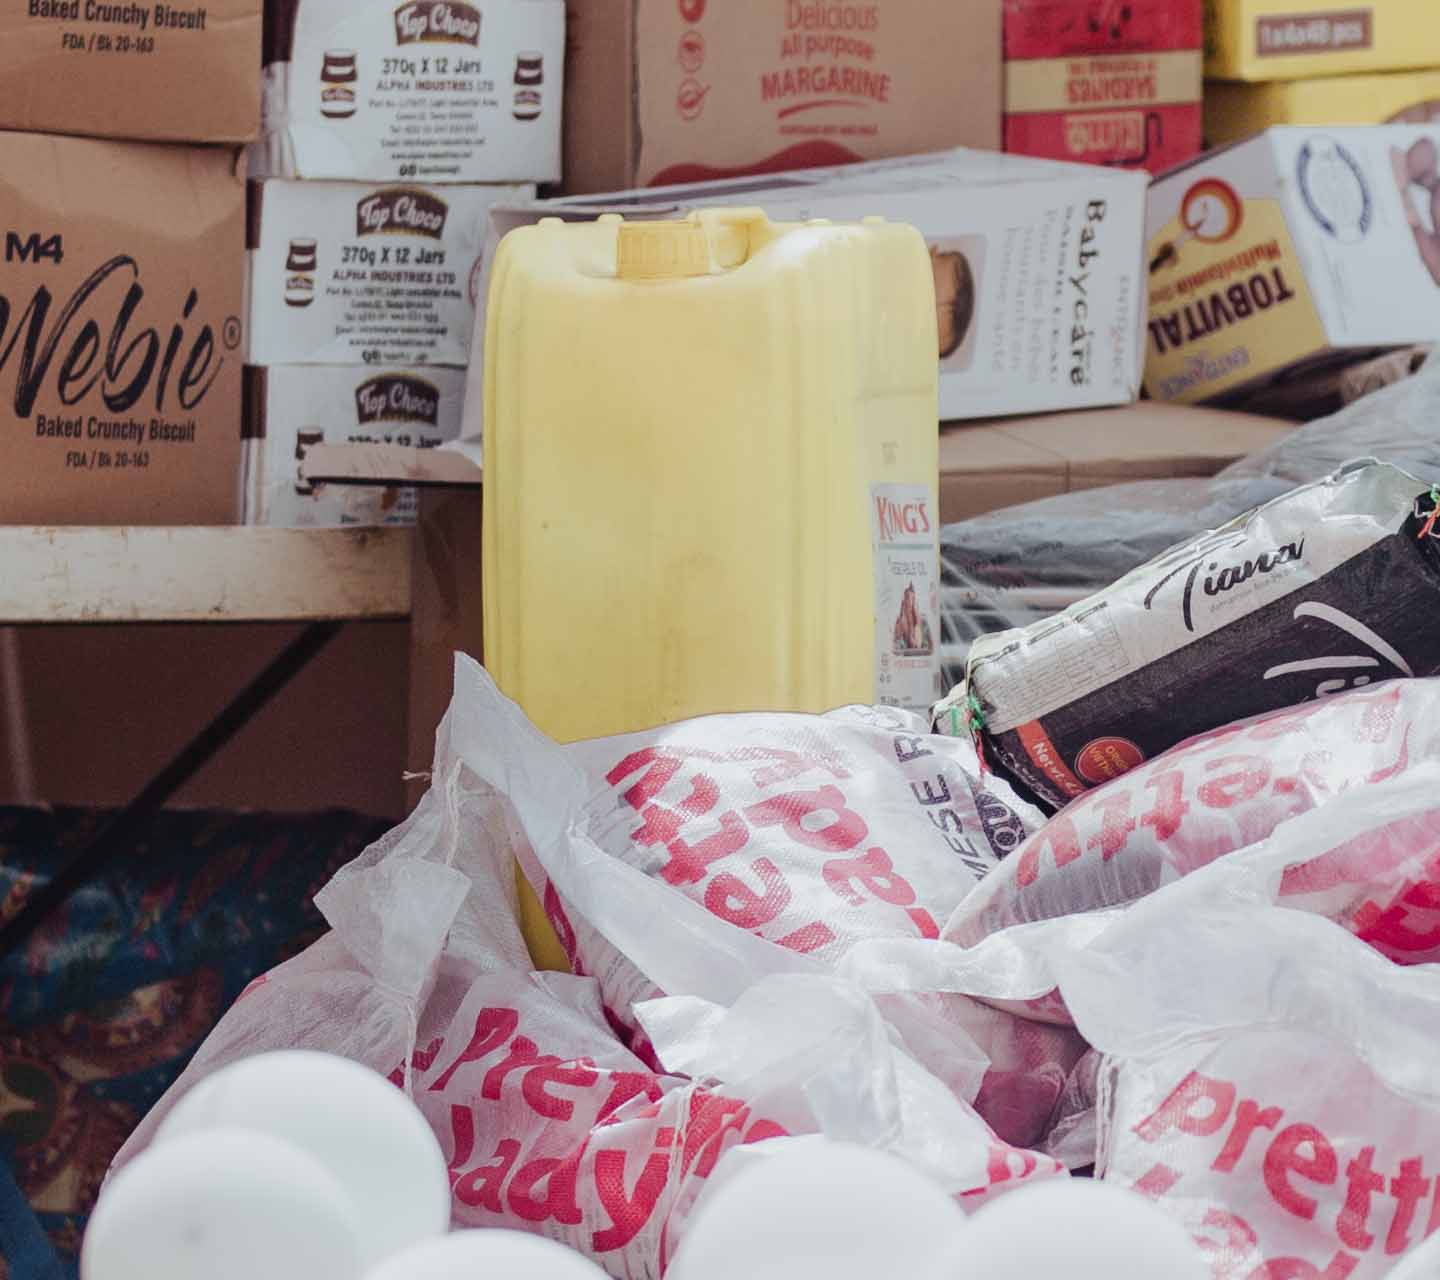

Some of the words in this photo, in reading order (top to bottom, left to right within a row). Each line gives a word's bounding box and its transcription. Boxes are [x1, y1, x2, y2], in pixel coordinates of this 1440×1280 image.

[85, 0, 151, 31] Crunchy
[154, 4, 208, 31] Biscuit
[62, 33, 86, 51] FDA
[760, 68, 892, 103] MARGARINE
[360, 198, 391, 233] Top
[393, 195, 444, 231] Choco
[6, 231, 64, 264] M4
[341, 245, 377, 267] 370g
[395, 247, 410, 264] 12
[415, 247, 446, 265] Jars
[1148, 266, 1296, 357] TOBVITAL
[360, 383, 387, 418] Top
[388, 382, 435, 416] Choco
[36, 414, 83, 438] Baked
[87, 416, 146, 445] Crunchy
[149, 419, 196, 443] Biscuit
[66, 450, 88, 468] FDA
[876, 494, 931, 542] KING'S
[1143, 530, 1306, 632] Tiana
